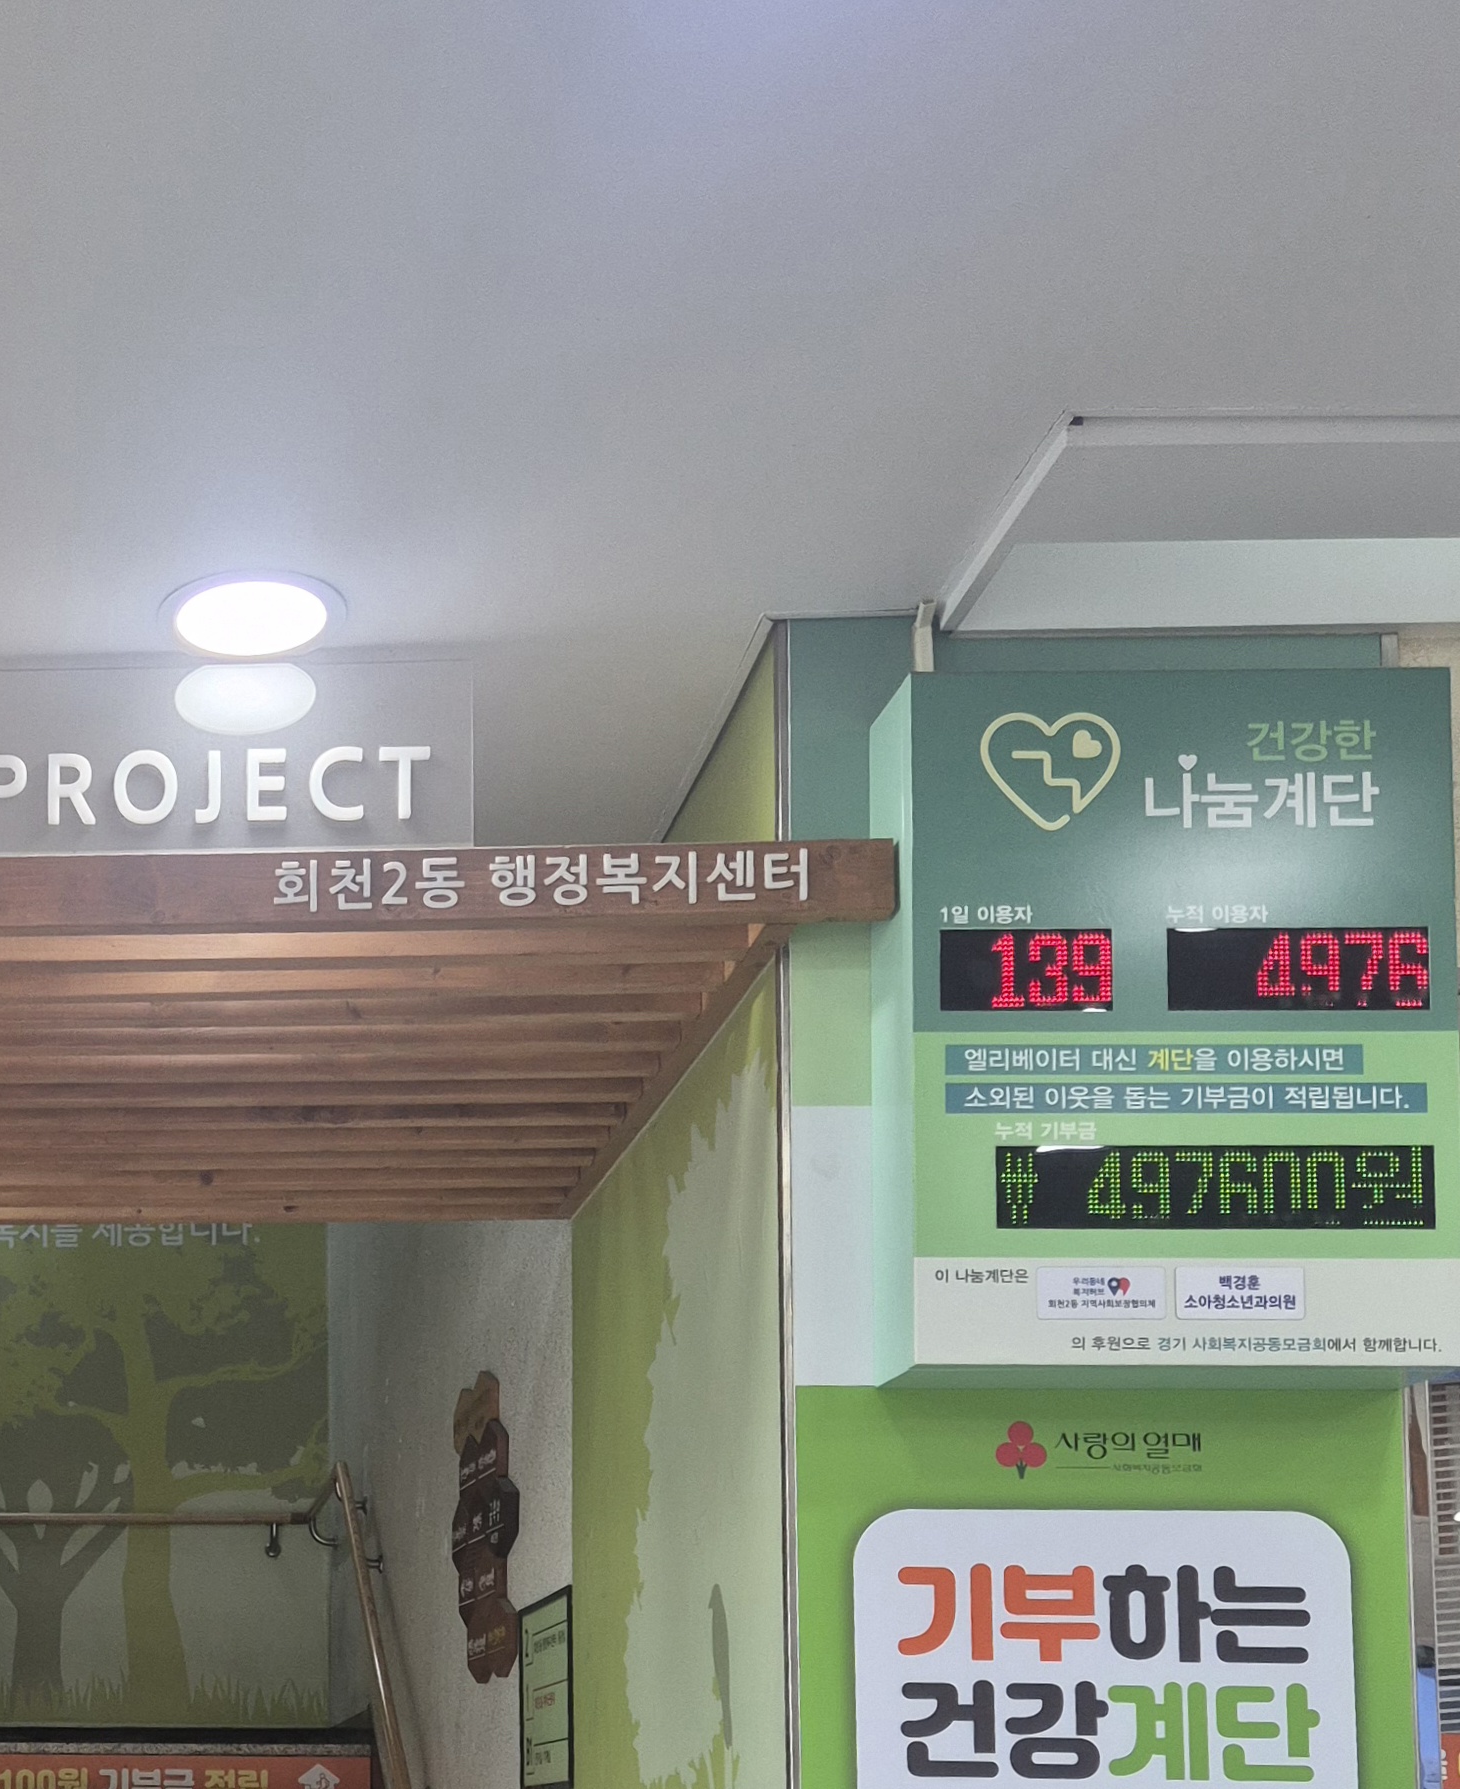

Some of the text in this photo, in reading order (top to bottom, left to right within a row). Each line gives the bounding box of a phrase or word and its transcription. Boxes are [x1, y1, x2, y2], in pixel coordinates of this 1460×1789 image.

[1245, 719, 1377, 762] 건강한
[1144, 770, 1380, 828] 나눔계단
[273, 848, 810, 911] 회천2동 행정복지센터
[941, 905, 1033, 924] 1일 이용자
[1165, 904, 1269, 924] 누적 이용자
[991, 932, 1113, 1009] 139
[1256, 931, 1430, 1008] 4976
[964, 1047, 1345, 1072] 엘리베이터 대신 계단을 이용하시면
[964, 1085, 1411, 1110] 소외된 이웃을 돕는 기부금이 적립됩니다.
[994, 1121, 1097, 1141] 누적 기부금
[934, 1267, 1029, 1284] 이 나눔계단은
[1218, 1274, 1261, 1290] 백경훈
[1184, 1294, 1297, 1310] 소아청소년과의원
[1071, 1335, 1443, 1354] 의 후원으로 경기 사회복지공동모금회에서 함께합니다.
[1055, 1431, 1202, 1460] 사랑의 열매
[897, 1563, 1311, 1664] 기부하는
[900, 1679, 1321, 1782] 건강계단
